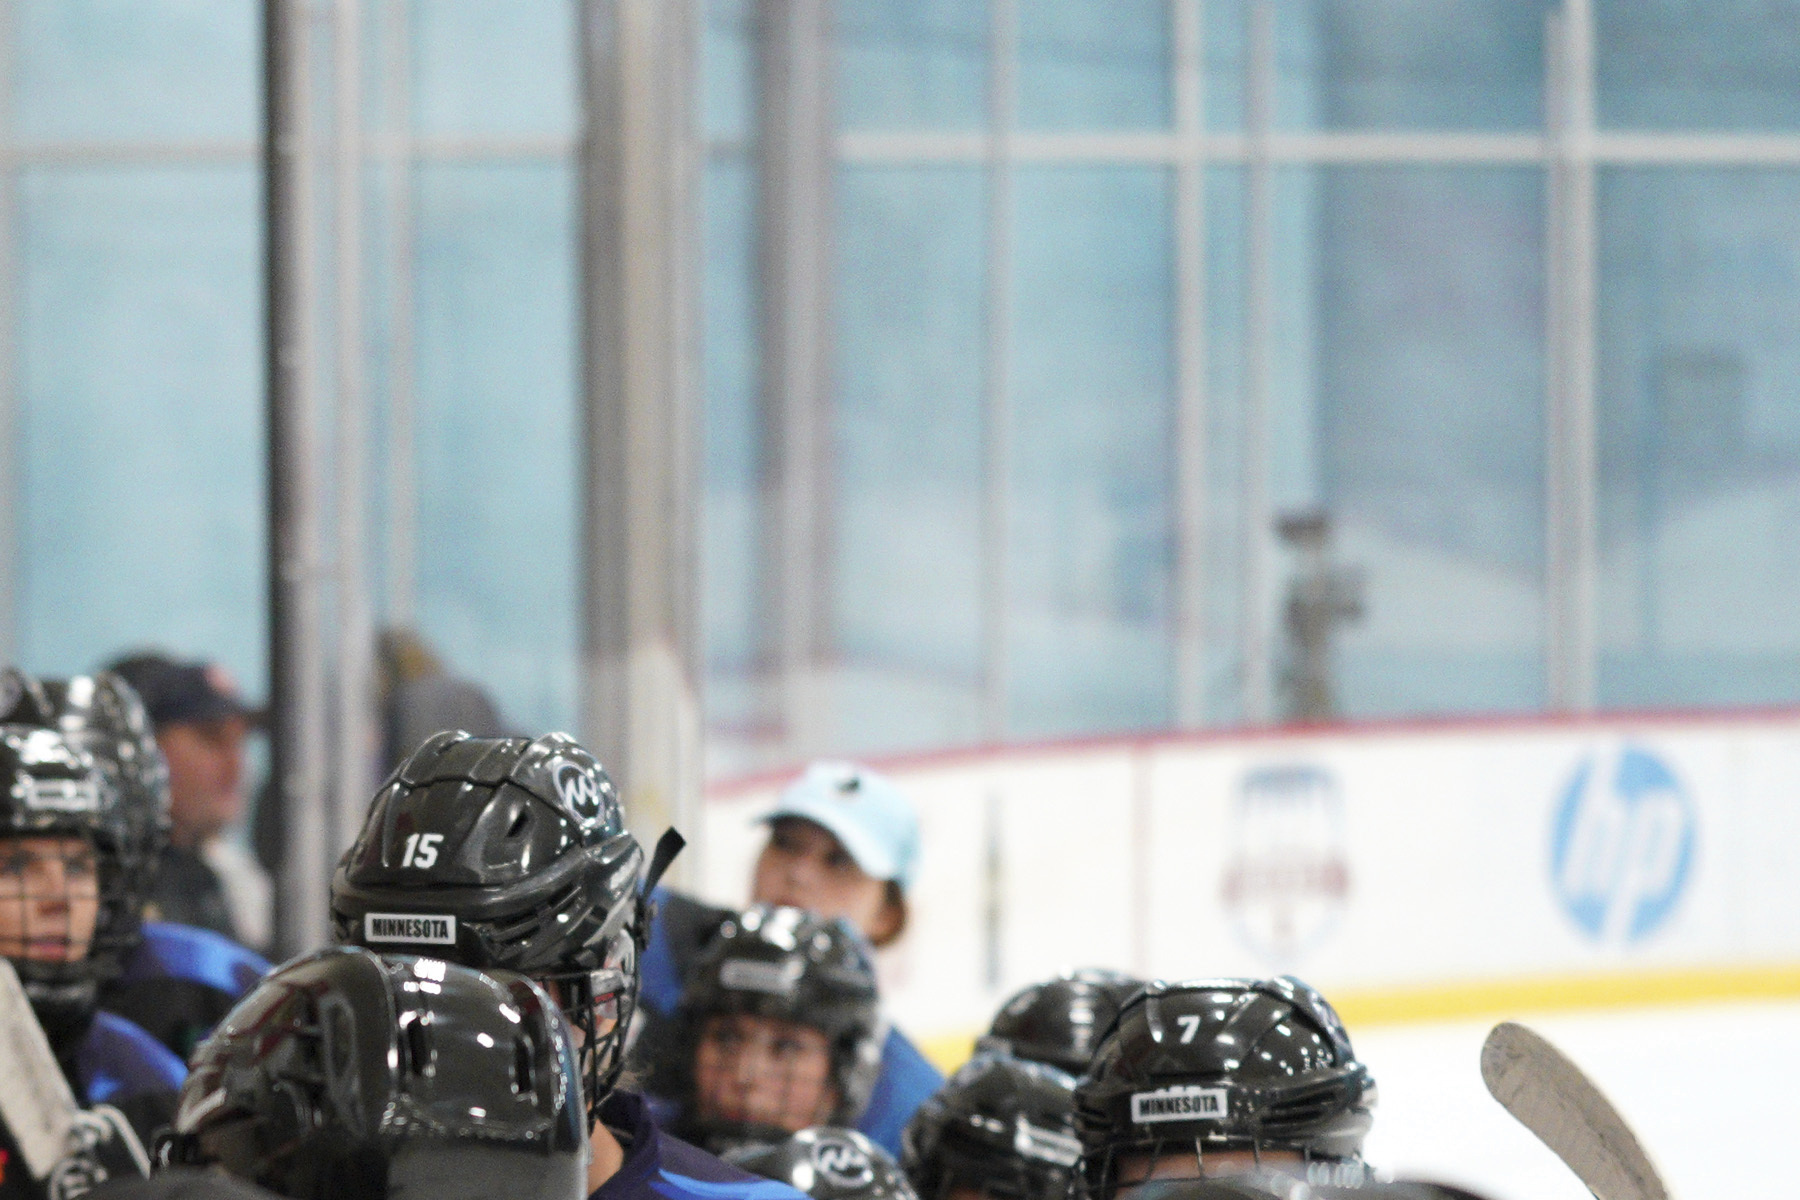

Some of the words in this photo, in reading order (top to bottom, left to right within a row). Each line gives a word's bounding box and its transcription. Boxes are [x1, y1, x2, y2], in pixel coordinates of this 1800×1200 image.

[402, 832, 444, 869] 15
[372, 918, 449, 938] MINNESOTA
[1177, 1015, 1201, 1044] 7
[1139, 1095, 1219, 1115] MINNESOTA
